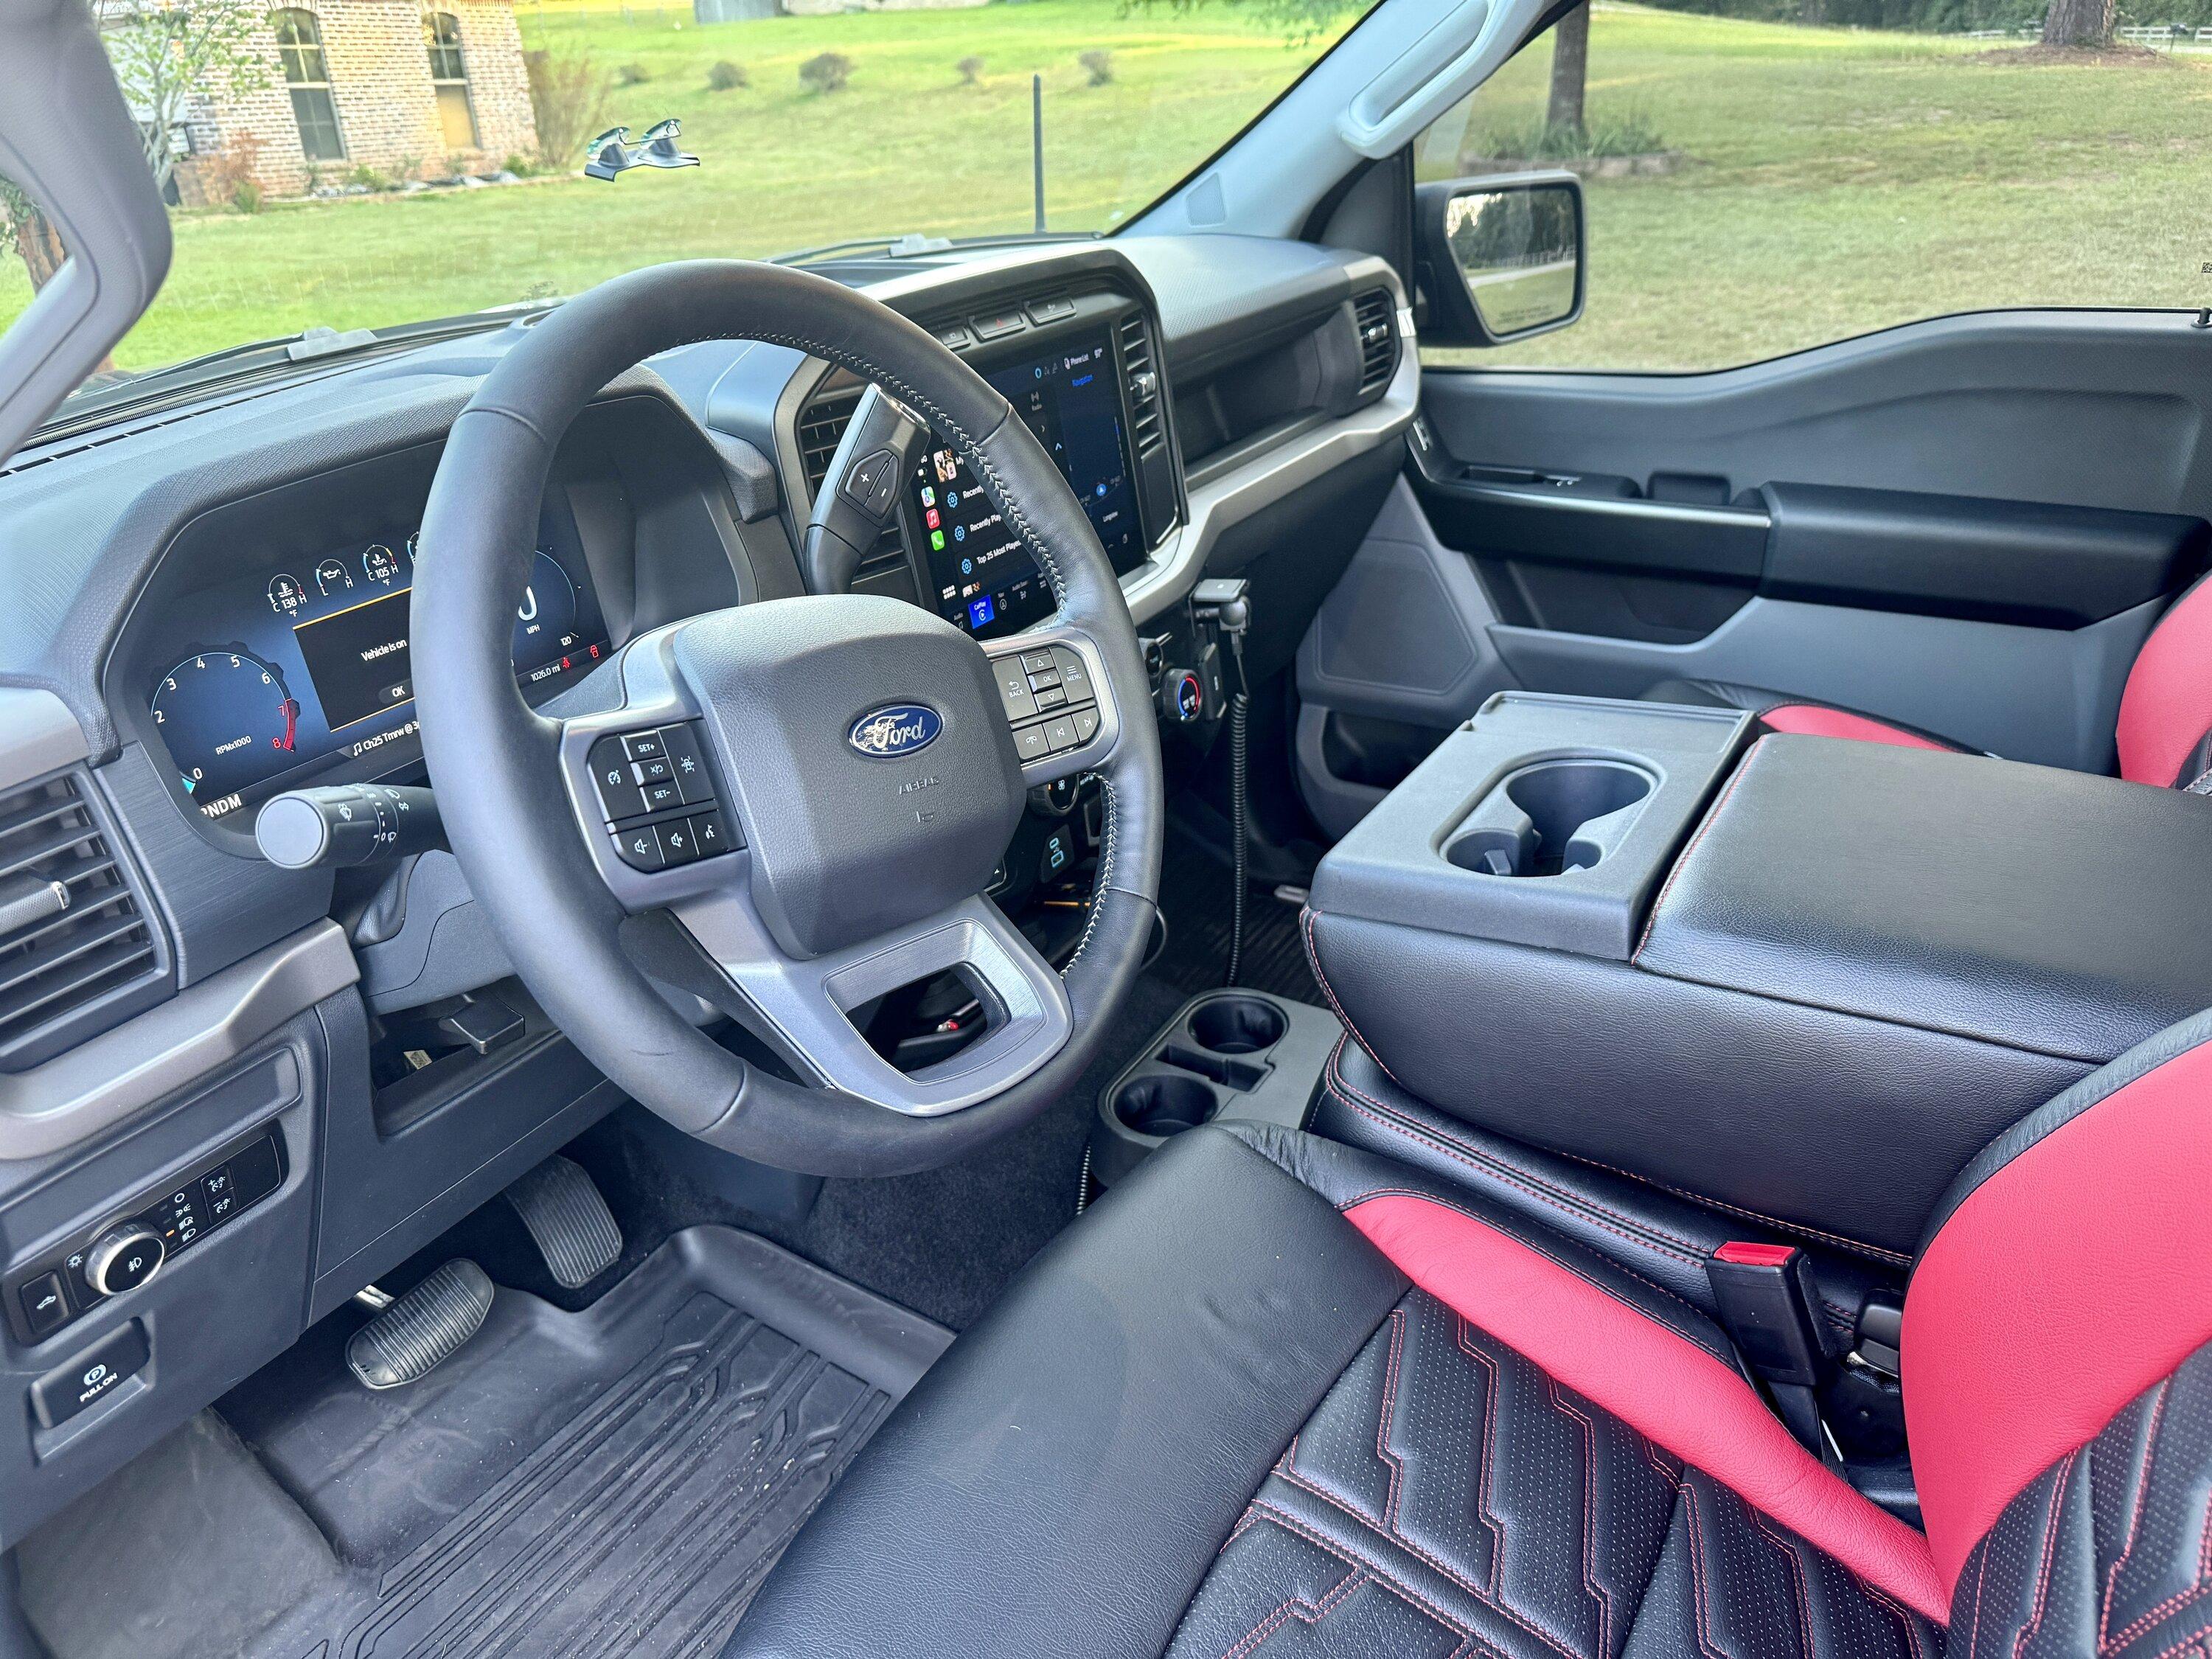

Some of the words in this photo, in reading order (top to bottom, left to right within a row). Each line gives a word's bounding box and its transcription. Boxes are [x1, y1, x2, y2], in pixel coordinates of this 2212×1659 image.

[962, 485, 984, 499] Recently
[970, 518, 991, 532] Recently
[976, 556, 987, 564] Top
[986, 551, 994, 560] 25
[993, 546, 1006, 557] Most
[368, 571, 375, 581] C
[375, 566, 390, 579] 105
[390, 564, 399, 574] H
[345, 577, 354, 588] H
[321, 587, 329, 597] L
[273, 602, 281, 612] C
[282, 597, 298, 609] 138
[299, 594, 307, 604] H
[526, 624, 540, 635] MPH
[560, 636, 572, 646] 120
[361, 644, 389, 661] Vehicle
[389, 642, 397, 652] is
[396, 639, 407, 649] on
[197, 657, 206, 669] 4
[230, 655, 240, 668] 5
[262, 672, 271, 684] 6
[531, 667, 552, 682] 1026.0
[552, 664, 561, 674] mi
[1066, 673, 1082, 682] MENU
[166, 678, 177, 691] 3
[392, 685, 406, 698] OK
[1009, 689, 1024, 698] BACK
[154, 710, 165, 723] 2
[277, 705, 285, 717] 7
[363, 735, 383, 751] Ch25
[381, 727, 405, 743] Tmrw
[404, 723, 413, 734] @
[869, 712, 927, 749] Ford
[215, 735, 251, 755] RPMx1000
[272, 737, 281, 748] 8
[192, 767, 203, 779] 0
[898, 776, 940, 796] AIRBAG
[80, 1384, 103, 1402] PULL
[102, 1372, 118, 1386] ON
